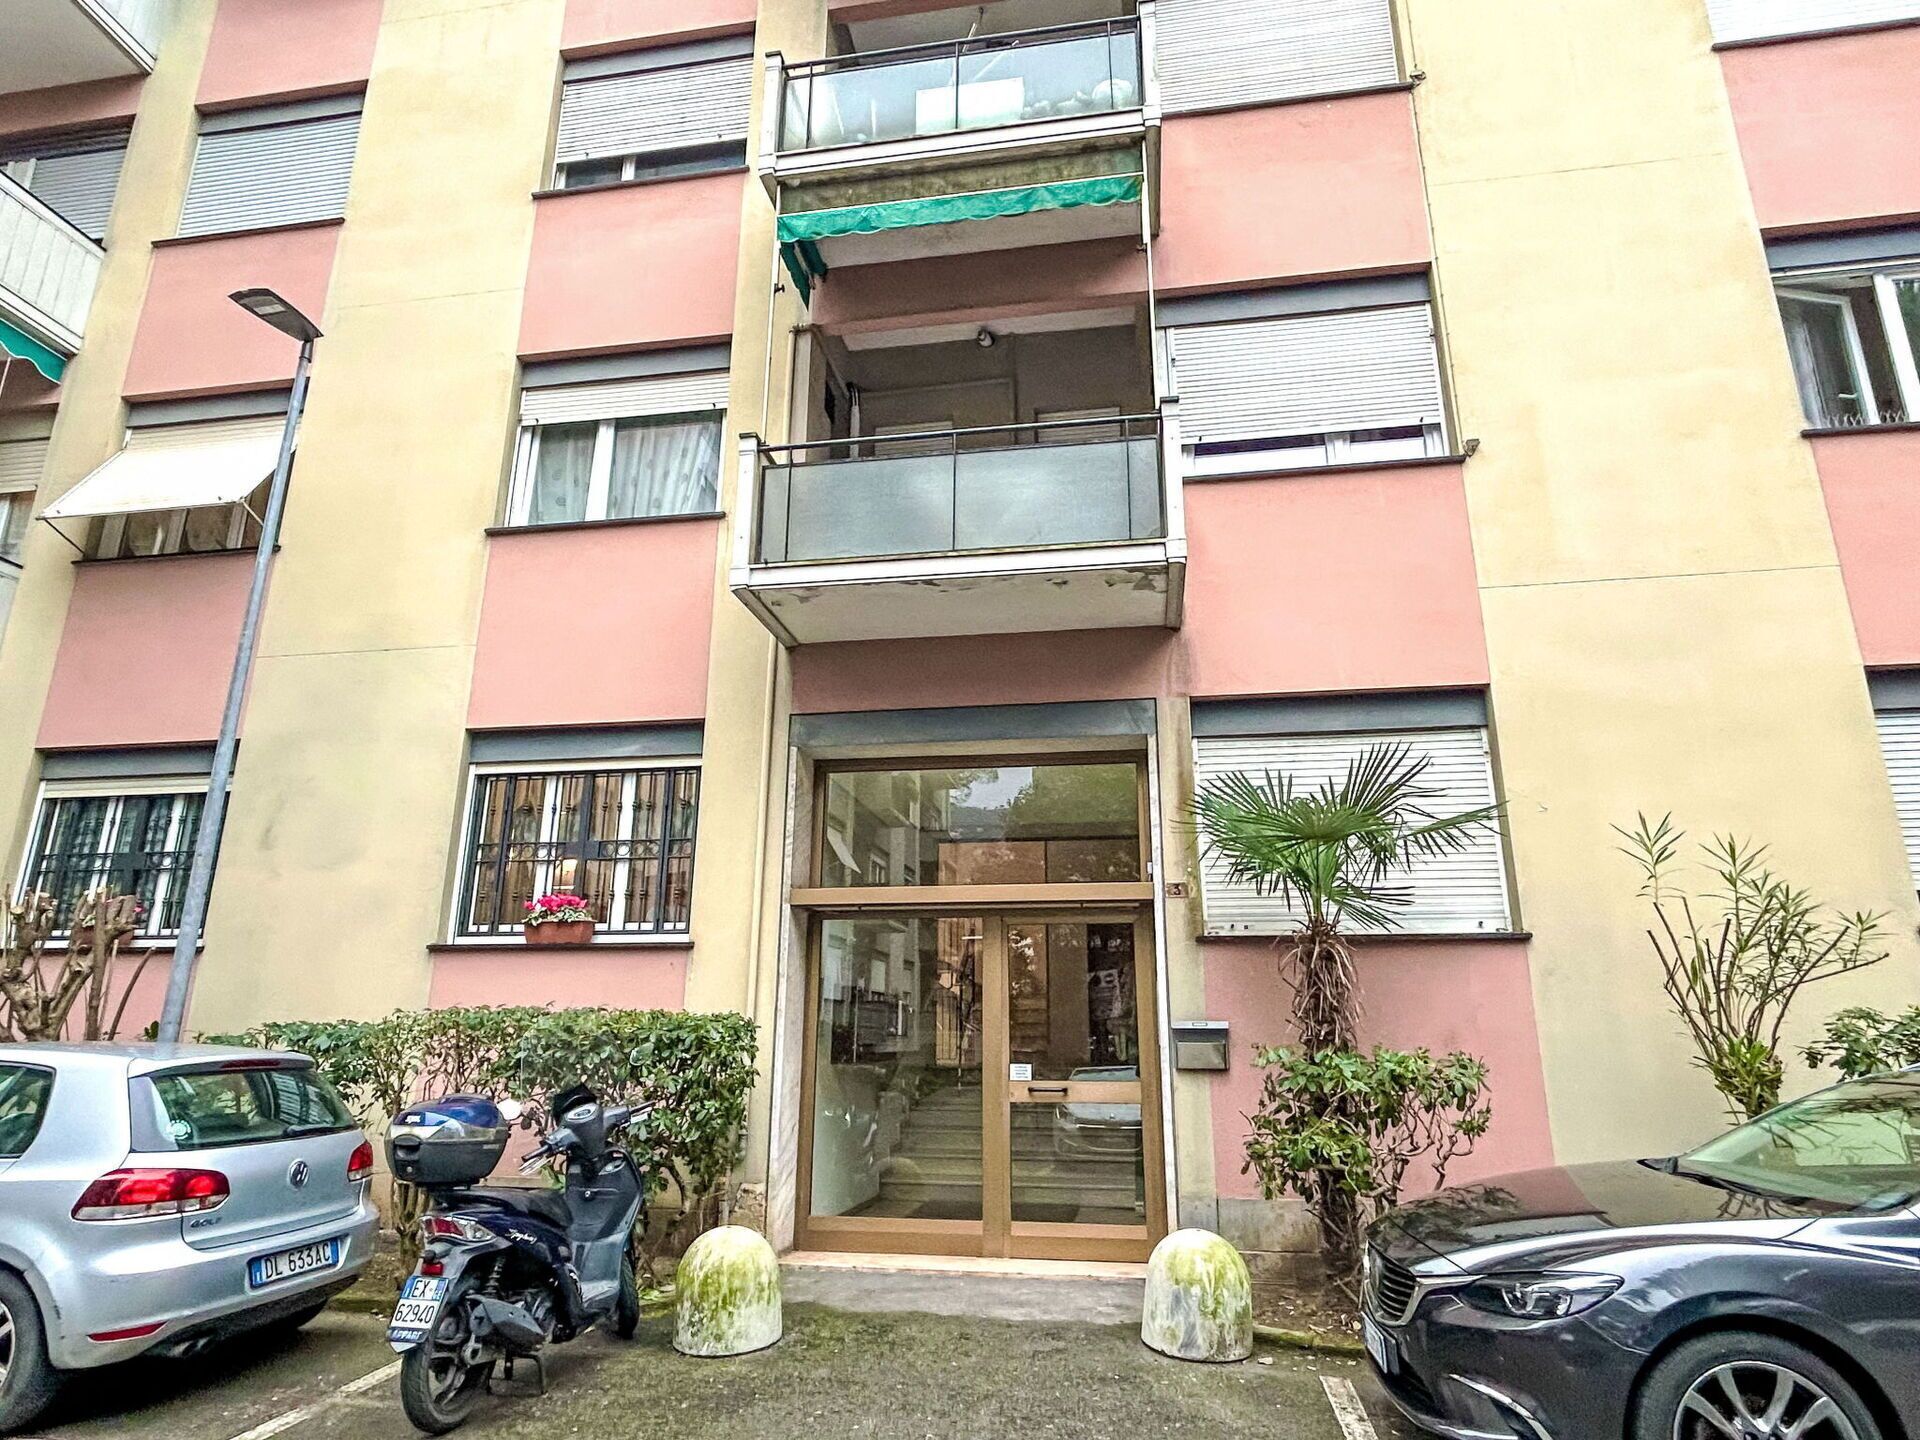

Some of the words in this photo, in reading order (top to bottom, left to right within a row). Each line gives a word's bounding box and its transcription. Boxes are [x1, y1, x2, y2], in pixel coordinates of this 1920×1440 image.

[1173, 883, 1181, 895] 3
[264, 1257, 283, 1279] DL
[288, 1242, 331, 1272] 633AC
[411, 1280, 432, 1298] EX
[394, 1303, 435, 1324] 62940
